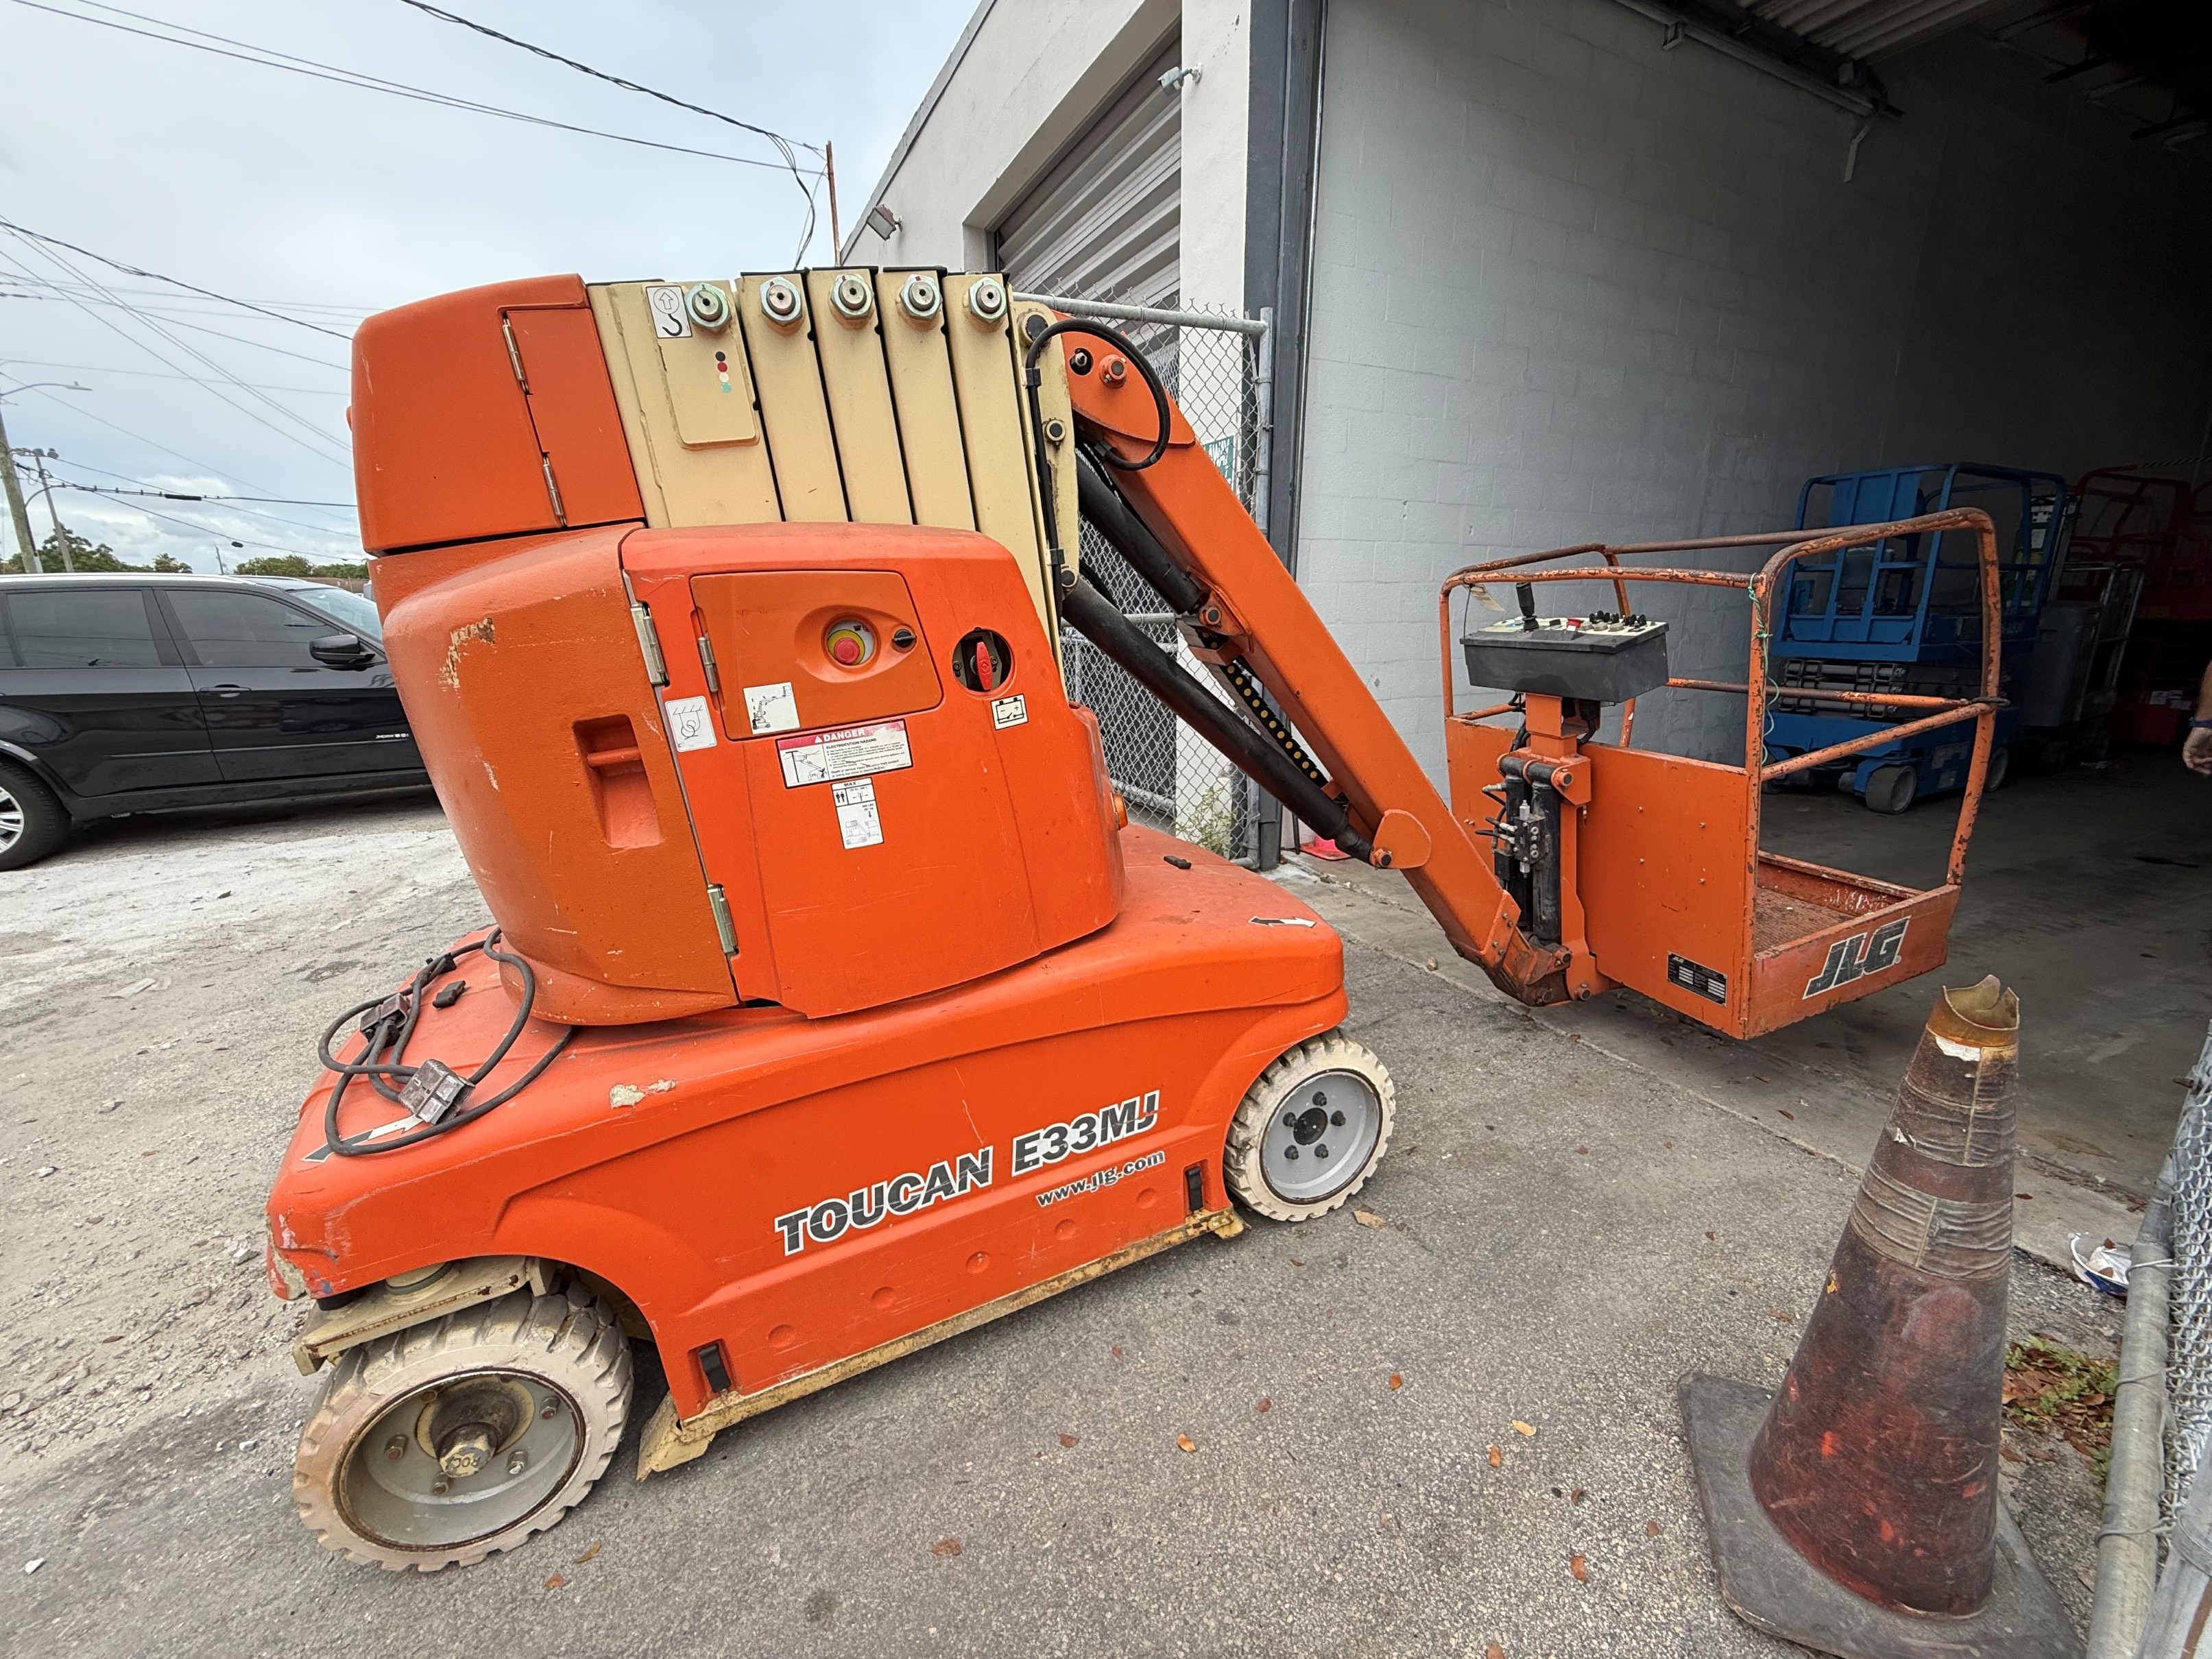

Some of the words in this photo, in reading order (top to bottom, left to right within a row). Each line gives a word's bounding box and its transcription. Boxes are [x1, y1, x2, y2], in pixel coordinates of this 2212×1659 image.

[824, 729, 865, 742] DANGER
[826, 741, 859, 749] ELECTROCUTION
[1802, 915, 1912, 1000] JLG
[775, 1145, 994, 1256] TOUCAN
[1011, 1089, 1161, 1176] E33MJ
[1036, 1150, 1165, 1207] www.jlg.com
